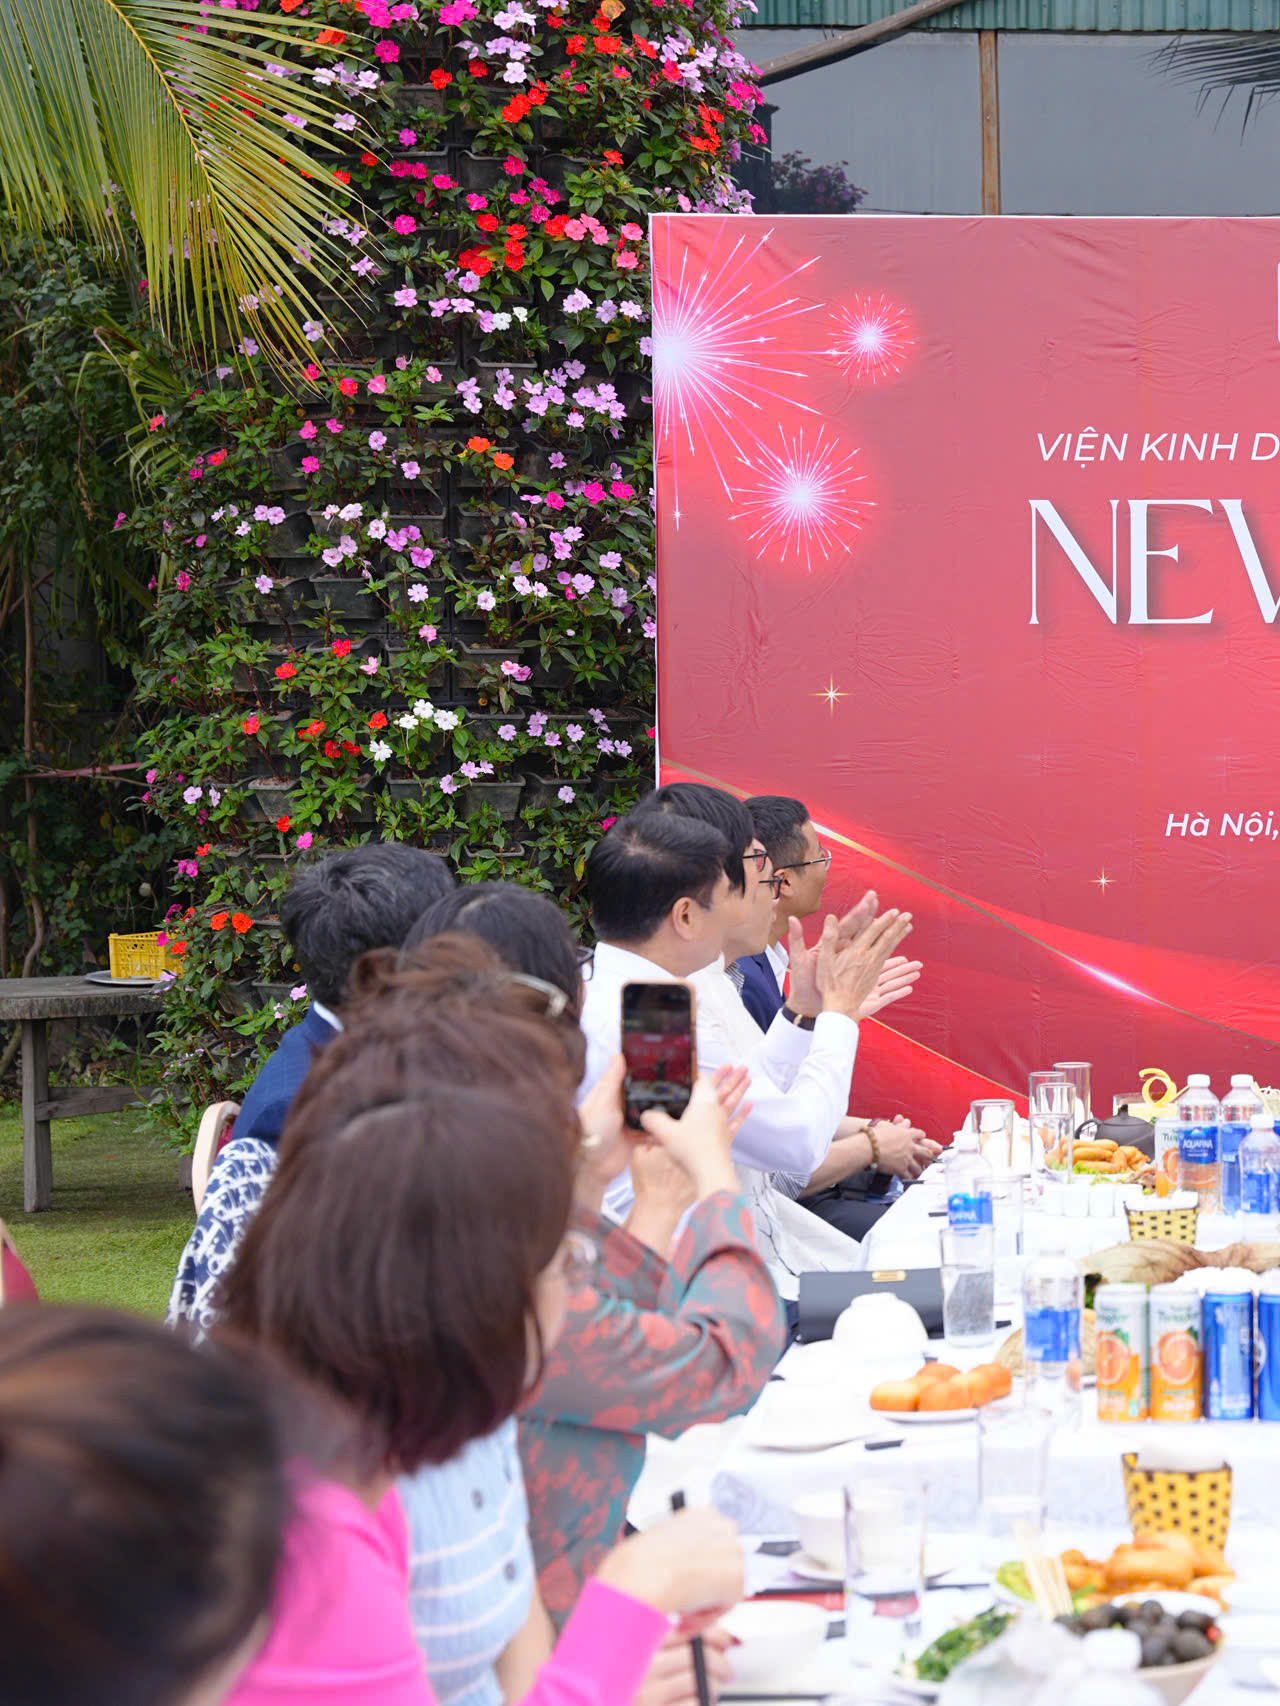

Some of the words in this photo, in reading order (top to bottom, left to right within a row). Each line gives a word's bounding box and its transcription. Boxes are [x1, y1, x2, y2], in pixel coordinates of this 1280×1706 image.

[1037, 426, 1129, 469] VIỆN
[1140, 432, 1239, 462] KINH
[1165, 812, 1210, 837] Hà
[1220, 811, 1280, 841] Nội,
